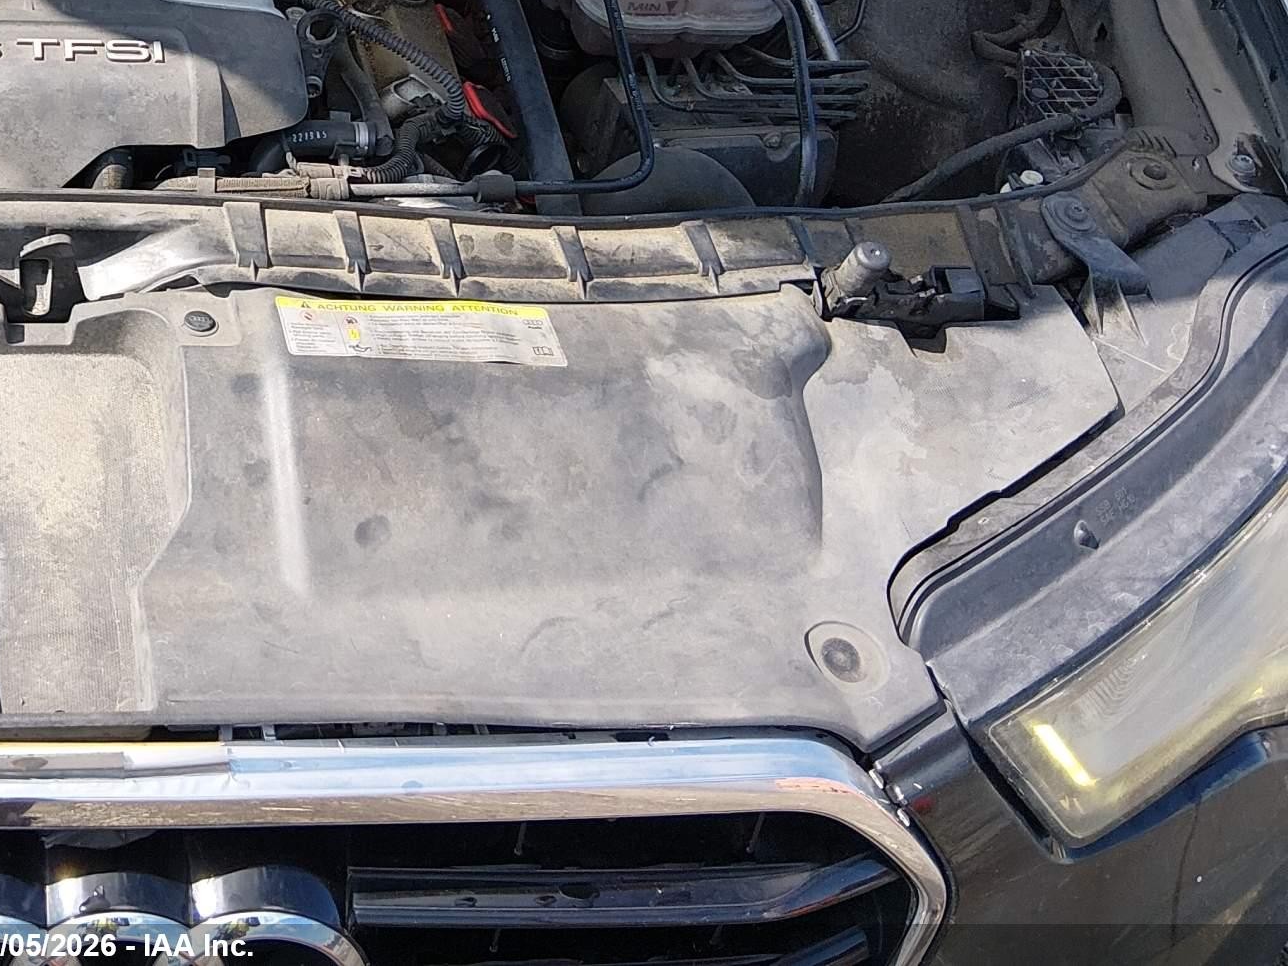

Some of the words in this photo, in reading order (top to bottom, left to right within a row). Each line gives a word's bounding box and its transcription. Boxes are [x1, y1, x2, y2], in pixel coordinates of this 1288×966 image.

[626, 0, 662, 12] MIN
[16, 38, 166, 63] TFSI
[317, 303, 377, 312] ACHTUNG
[383, 304, 445, 313] WARNING
[451, 304, 519, 316] ATTENTION
